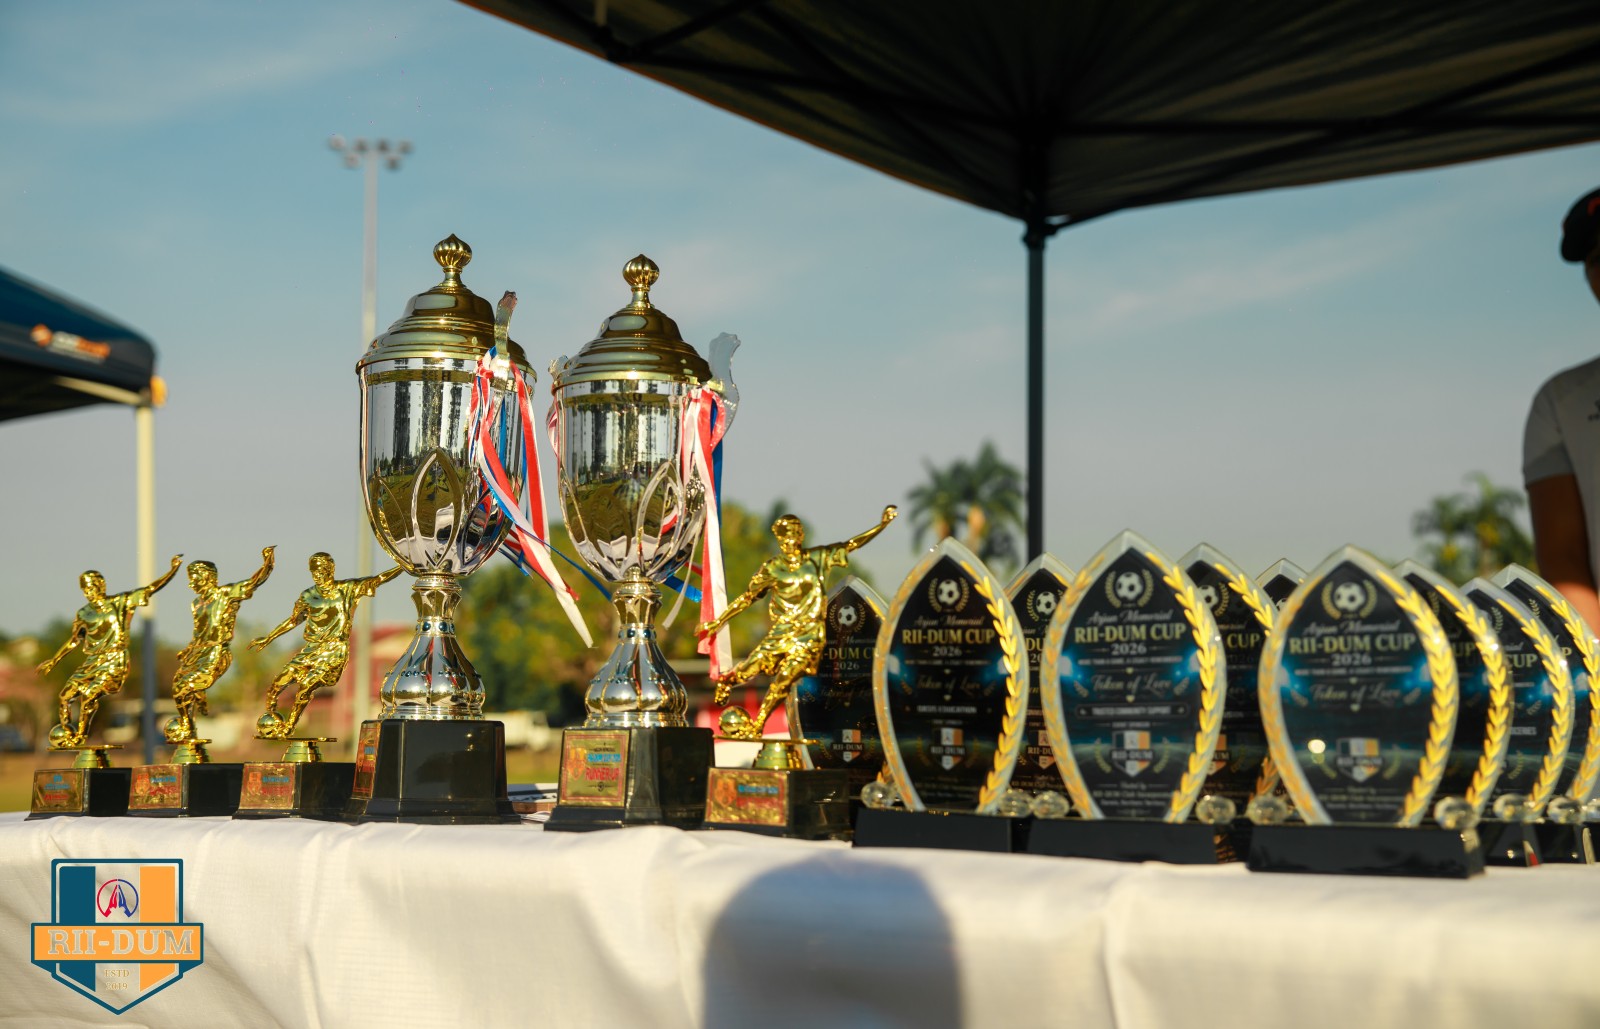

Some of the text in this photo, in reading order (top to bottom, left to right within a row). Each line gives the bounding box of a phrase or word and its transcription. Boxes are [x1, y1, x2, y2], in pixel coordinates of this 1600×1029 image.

[944, 614, 985, 626] Memorial
[1120, 609, 1174, 622] Memorial
[1074, 622, 1187, 643] RII-DUM CUP
[1340, 619, 1400, 634] Memorial
[902, 628, 996, 645] RII-DUM CUP
[1227, 632, 1260, 648] CUP
[1289, 632, 1416, 655] RII-DUM CUP
[932, 646, 962, 657] 2026
[1111, 643, 1147, 656] 2026
[1454, 642, 1475, 657] UP
[833, 661, 860, 670] 2026
[1331, 653, 1372, 667] 2026
[1126, 675, 1141, 695] of
[1027, 746, 1054, 755] RII-DU
